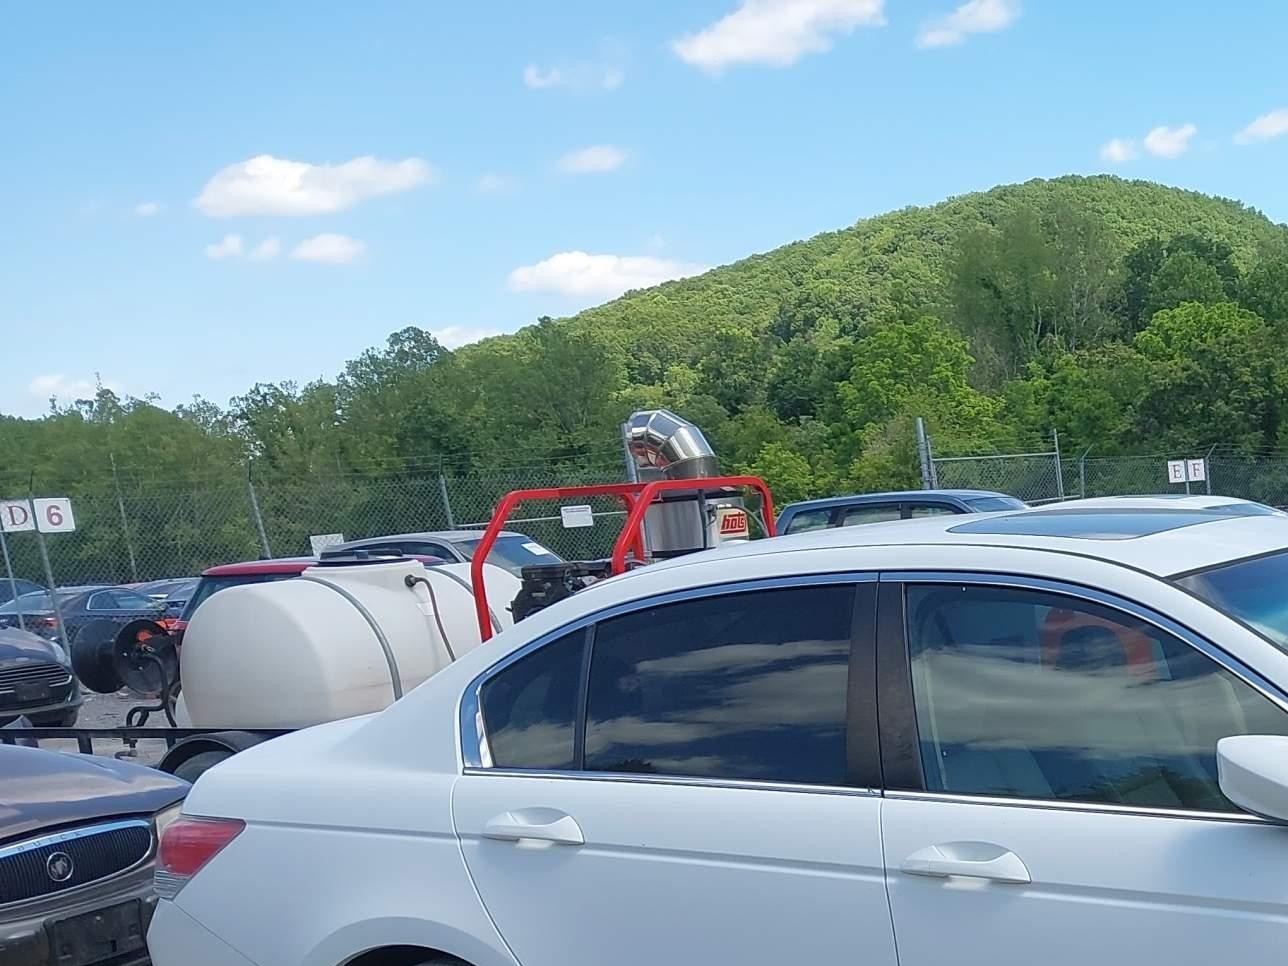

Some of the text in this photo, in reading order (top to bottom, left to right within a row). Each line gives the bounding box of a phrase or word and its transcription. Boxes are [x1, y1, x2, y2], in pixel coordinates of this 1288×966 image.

[1172, 464, 1183, 479] E
[1191, 462, 1203, 478] F
[7, 505, 29, 526] D
[46, 504, 64, 526] 6
